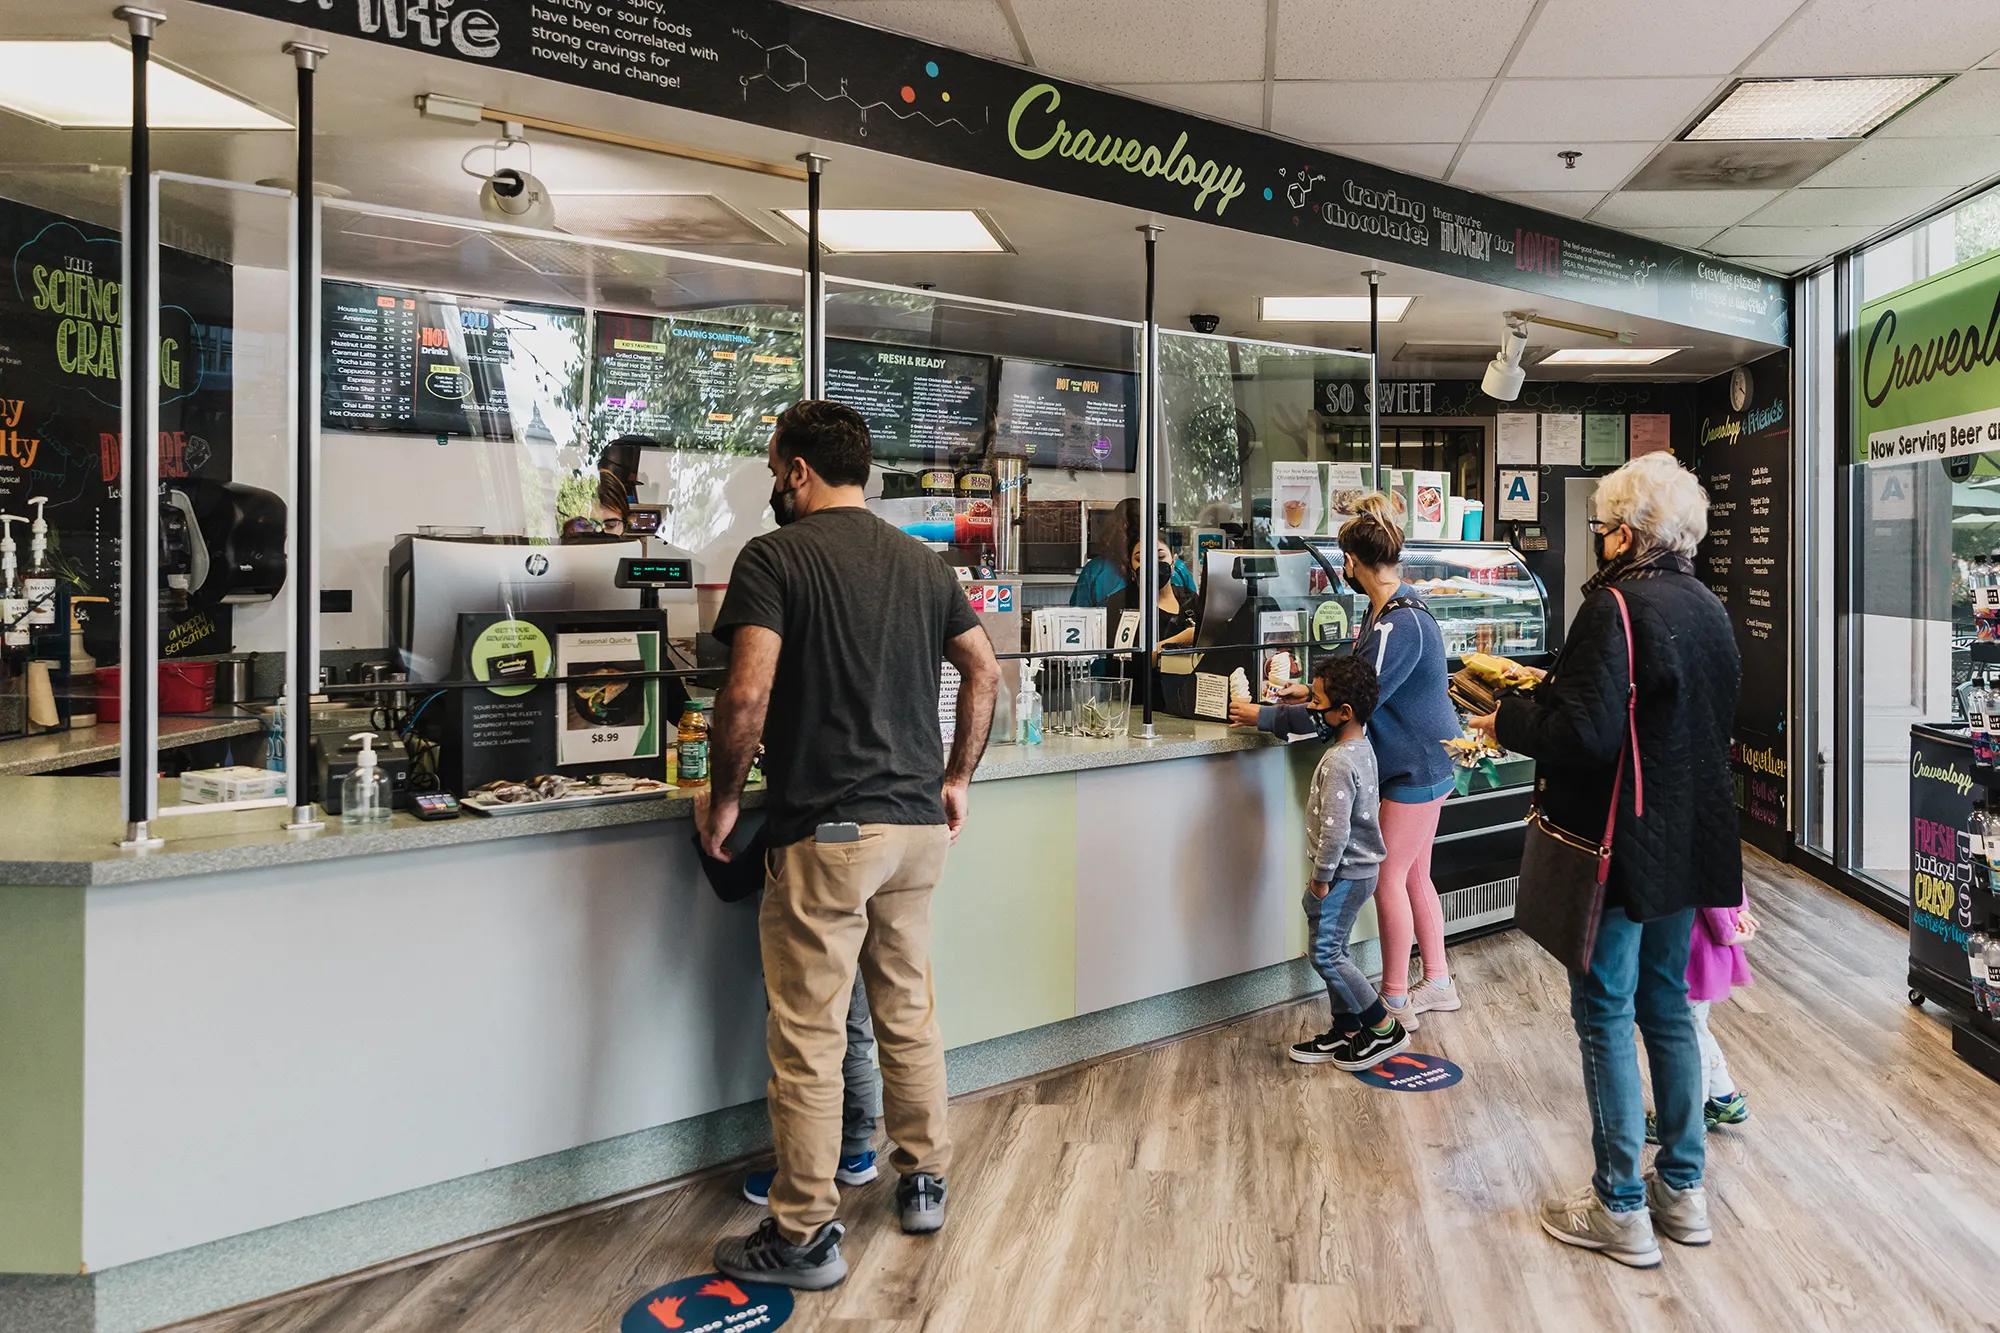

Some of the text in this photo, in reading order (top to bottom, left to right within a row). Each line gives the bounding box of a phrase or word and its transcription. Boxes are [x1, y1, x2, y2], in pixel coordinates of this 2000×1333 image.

[596, 5, 613, 17] or
[617, 9, 649, 27] sour
[653, 18, 692, 38] foods
[531, 5, 719, 62] have been correlated with
[531, 26, 671, 68] strong cravings for
[532, 45, 681, 88] novelty and change!
[1007, 83, 1246, 216] Craveology
[1342, 179, 1426, 223] Craving
[1322, 202, 1429, 246] Chocolate?
[1432, 206, 1482, 229] then you're
[1440, 221, 1493, 262] HUNGRY
[1515, 228, 1560, 278] LOVE!
[1563, 250, 1583, 260] chocolate
[1572, 242, 1592, 253] feel-good
[1592, 249, 1610, 258] chemical
[64, 255, 93, 274] THE
[1697, 261, 1734, 290] Craving
[343, 315, 377, 323] Americano
[460, 312, 489, 328] COLD
[422, 327, 448, 348] HOT
[462, 328, 487, 336] Drinks
[672, 329, 708, 339] CRAVING
[331, 340, 359, 348] Hazelnut
[421, 347, 448, 356] Drinks
[338, 367, 376, 375] Cappuccino
[877, 352, 946, 369] FRESH & READY
[1056, 378, 1070, 391] HOT
[1082, 380, 1099, 393] OVEN
[1326, 383, 1354, 413] SO
[1701, 415, 1741, 447] Craveology
[1748, 398, 1784, 436] Friends
[1870, 440, 1895, 460] Now
[1898, 430, 1946, 456] Serving
[1950, 424, 1983, 448] Beer
[1507, 476, 1531, 501] A
[608, 636, 632, 645] Quiche
[1066, 627, 1080, 643] 2
[1121, 627, 1130, 643] 6
[591, 732, 619, 744] $8.99
[1743, 743, 1786, 778] together
[1912, 751, 1973, 796] Craveology
[1914, 817, 1955, 862] FRESH
[1915, 851, 1955, 881] juicy!
[1914, 872, 1955, 920] CRISP
[1390, 1067, 1445, 1086] Please keep
[1427, 1072, 1452, 1084] apart
[722, 1313, 771, 1333] apart
[724, 1304, 769, 1325] keep
